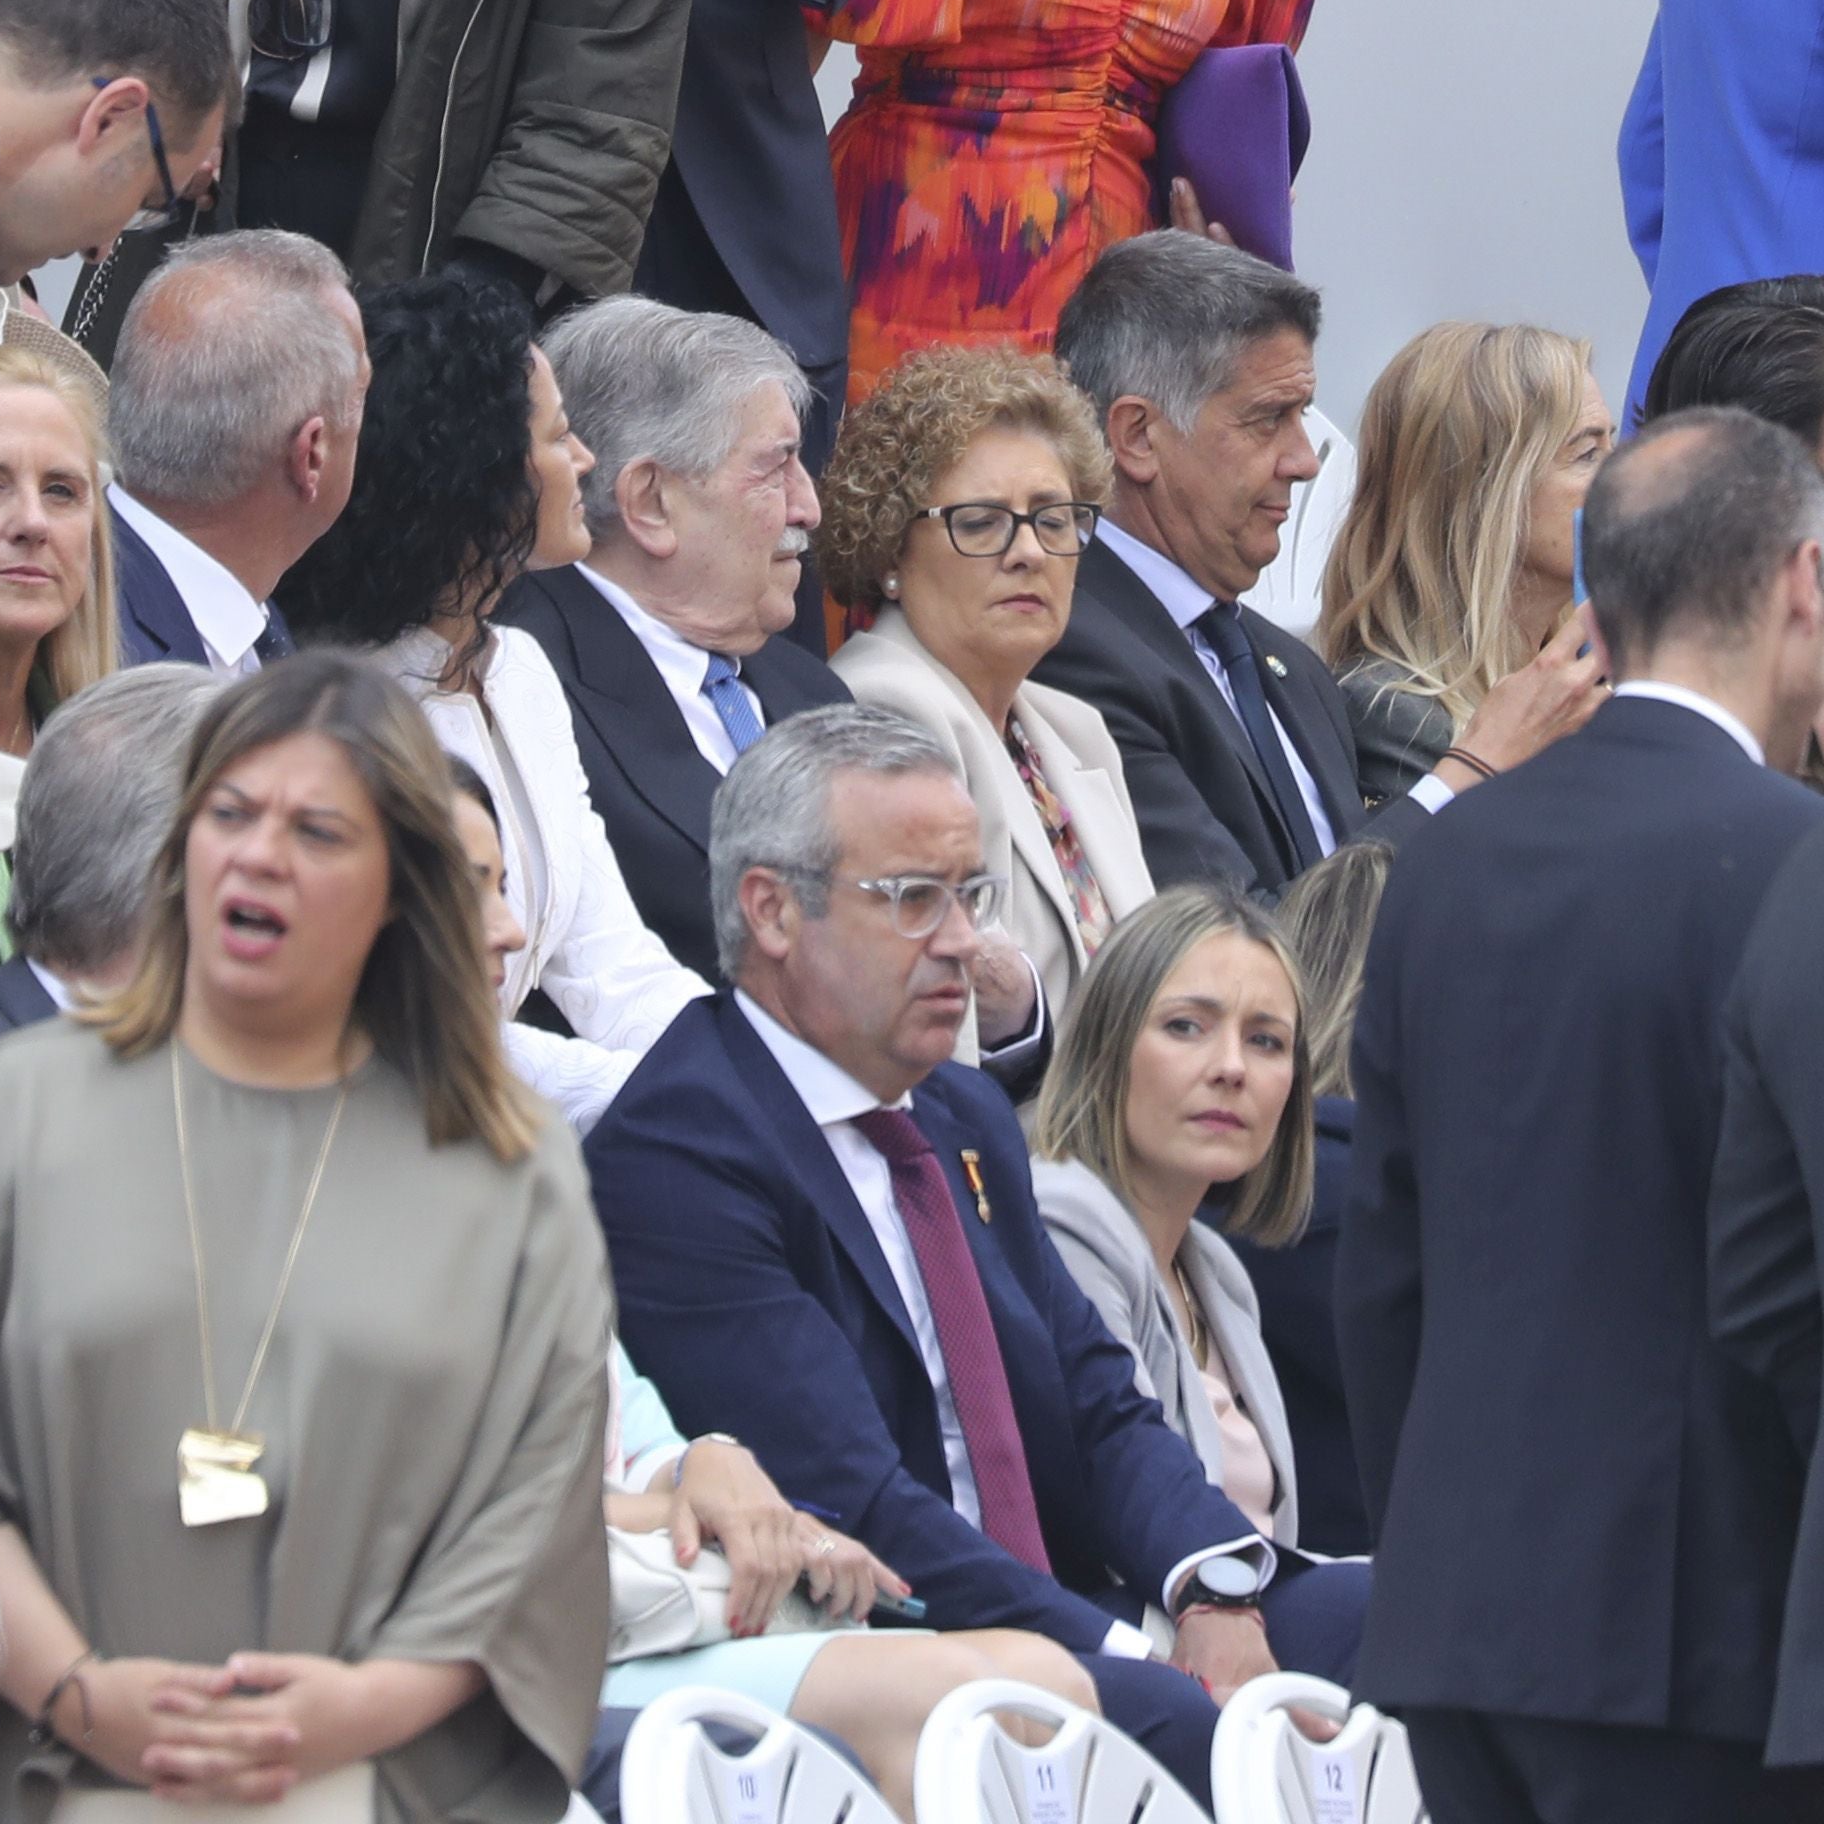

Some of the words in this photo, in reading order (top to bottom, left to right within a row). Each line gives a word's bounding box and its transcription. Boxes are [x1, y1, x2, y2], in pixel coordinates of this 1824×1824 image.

[737, 1775, 755, 1801] 10
[1036, 1765, 1054, 1791] 11
[1325, 1764, 1343, 1791] 12
